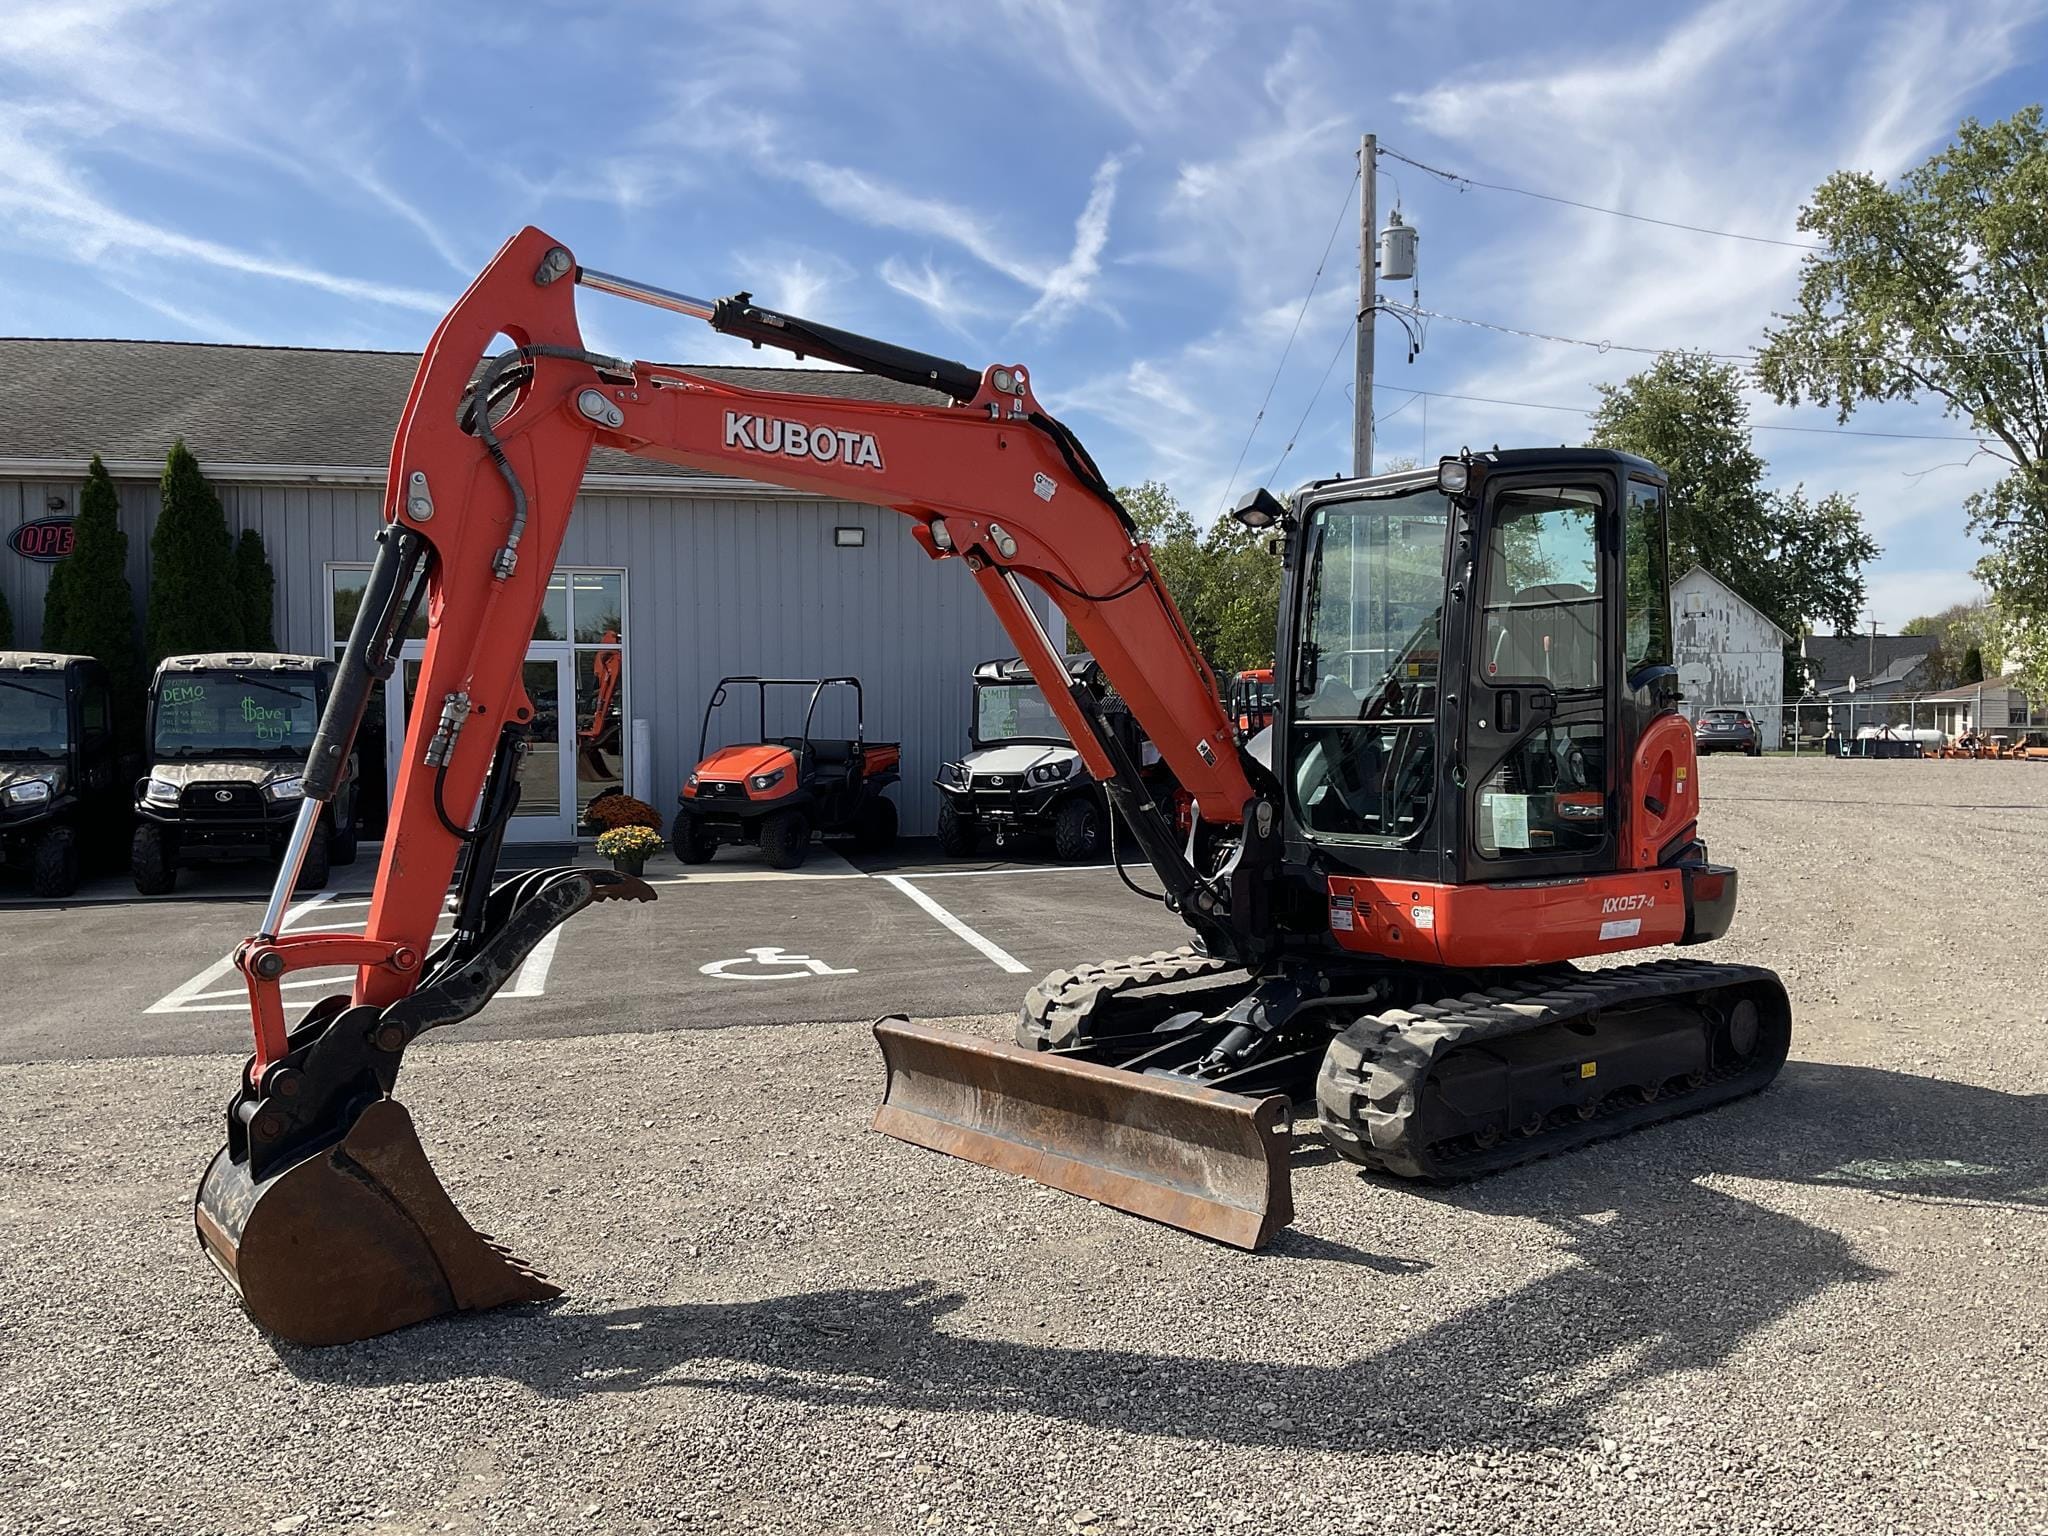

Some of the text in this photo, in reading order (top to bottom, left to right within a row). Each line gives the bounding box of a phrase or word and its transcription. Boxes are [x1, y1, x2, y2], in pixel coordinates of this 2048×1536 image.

[725, 411, 883, 468] KUBOTA
[20, 526, 76, 554] OPE
[162, 685, 205, 702] DEMO
